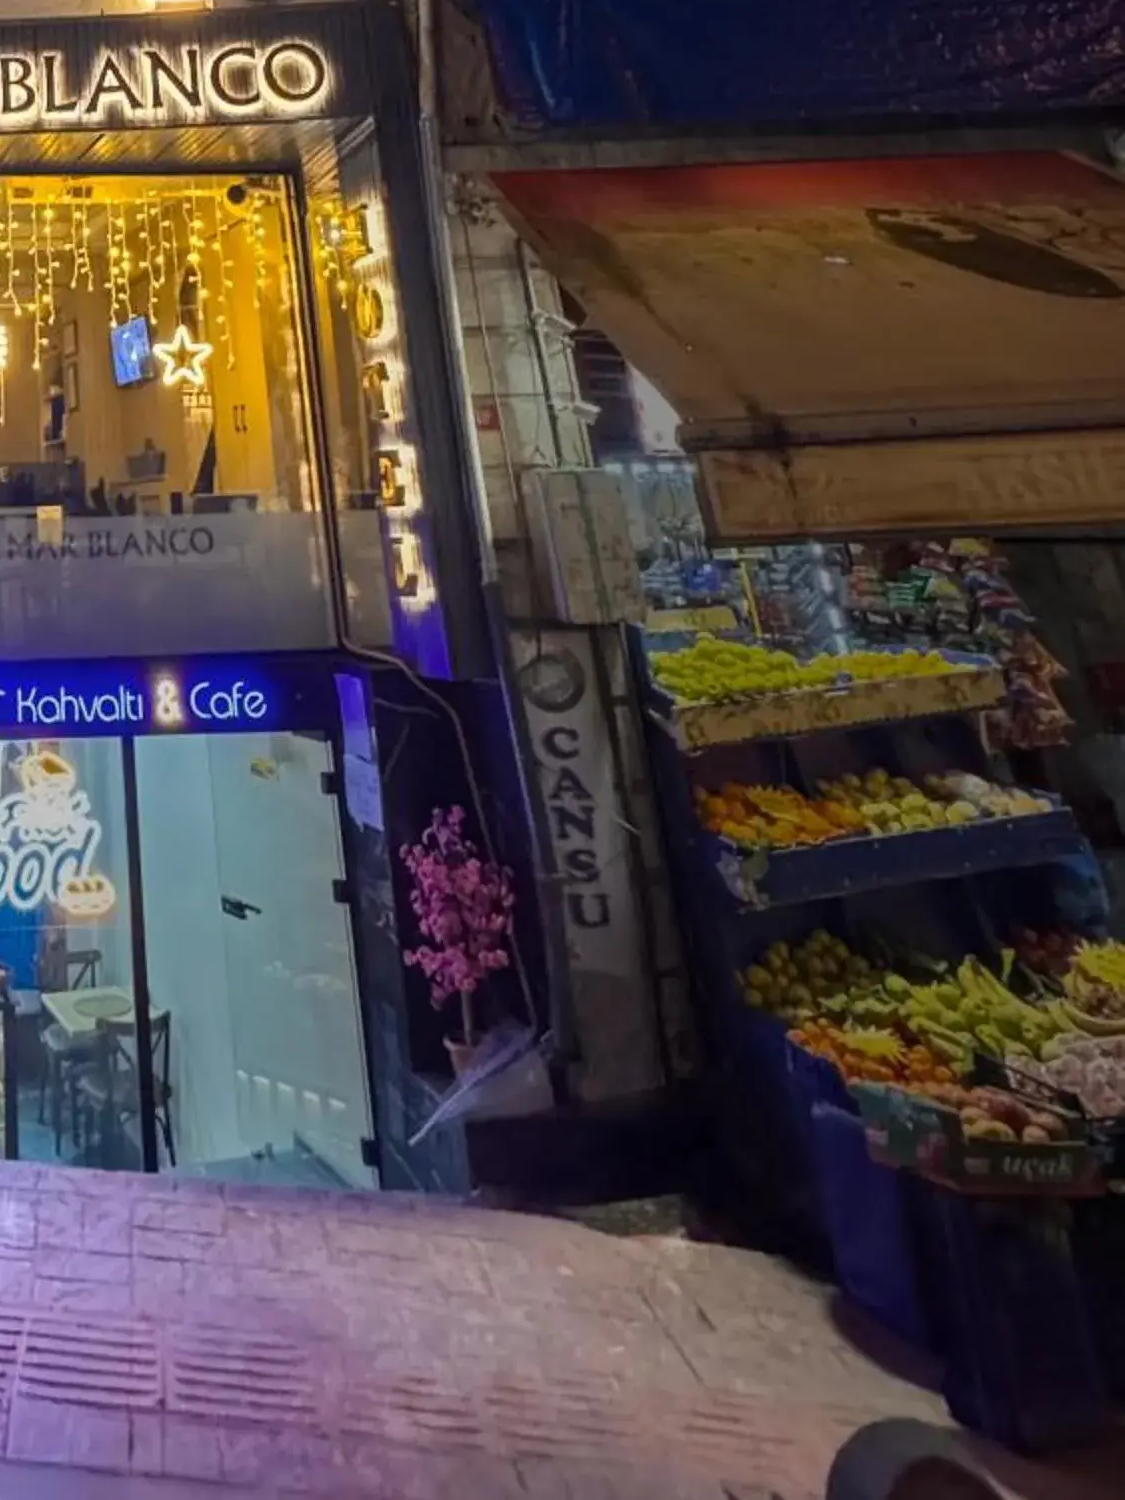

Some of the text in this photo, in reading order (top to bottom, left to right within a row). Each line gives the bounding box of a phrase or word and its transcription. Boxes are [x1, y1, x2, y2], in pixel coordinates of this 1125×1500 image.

[87, 527, 215, 559] BLANCO
[156, 680, 181, 720] &
[189, 680, 268, 721] Cafe
[541, 726, 610, 929] CANSU
